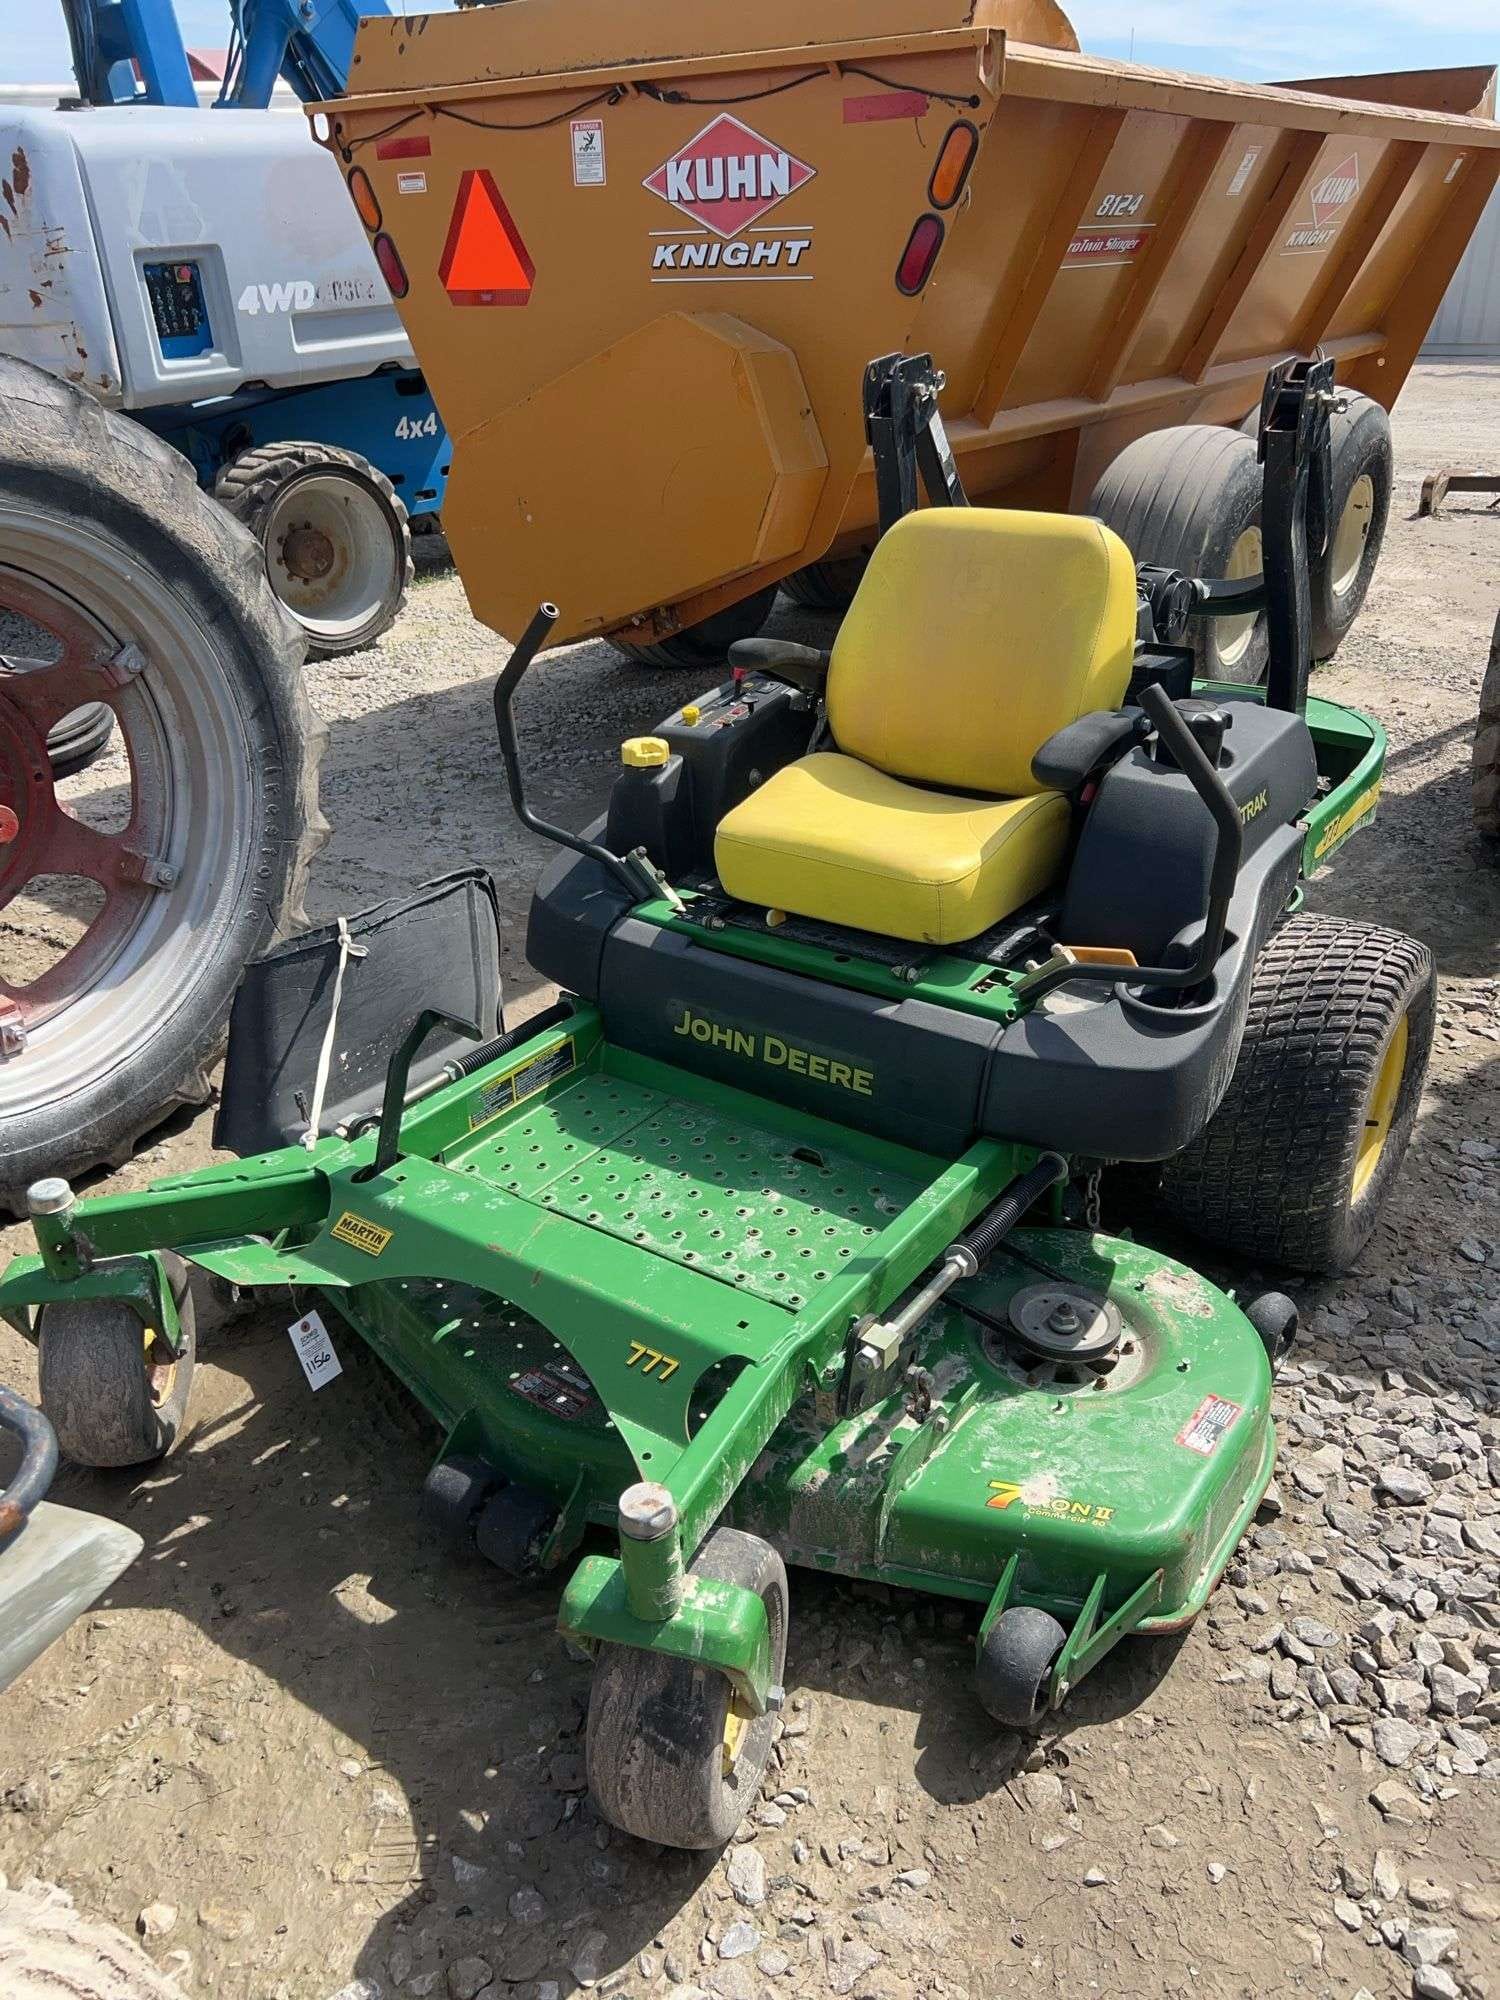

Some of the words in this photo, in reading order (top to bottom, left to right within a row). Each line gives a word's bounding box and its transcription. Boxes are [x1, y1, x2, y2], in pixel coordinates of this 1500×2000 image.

[666, 153, 791, 203] KUHN
[1313, 177, 1357, 204] KUHN
[1096, 194, 1144, 217] 8124
[1067, 239, 1105, 253] roTwin
[1103, 237, 1140, 252] Slinger
[1285, 229, 1336, 247] KNIGHT
[652, 240, 811, 268] KNIGHT
[237, 280, 315, 315] 4WD
[394, 412, 438, 440] 4x4
[1238, 789, 1267, 825] TRAK
[674, 1011, 755, 1058] JOHN
[763, 1035, 875, 1096] DEERE
[340, 1218, 386, 1246] MARTIN
[306, 1352, 331, 1374] 1156
[626, 1341, 680, 1382] 777
